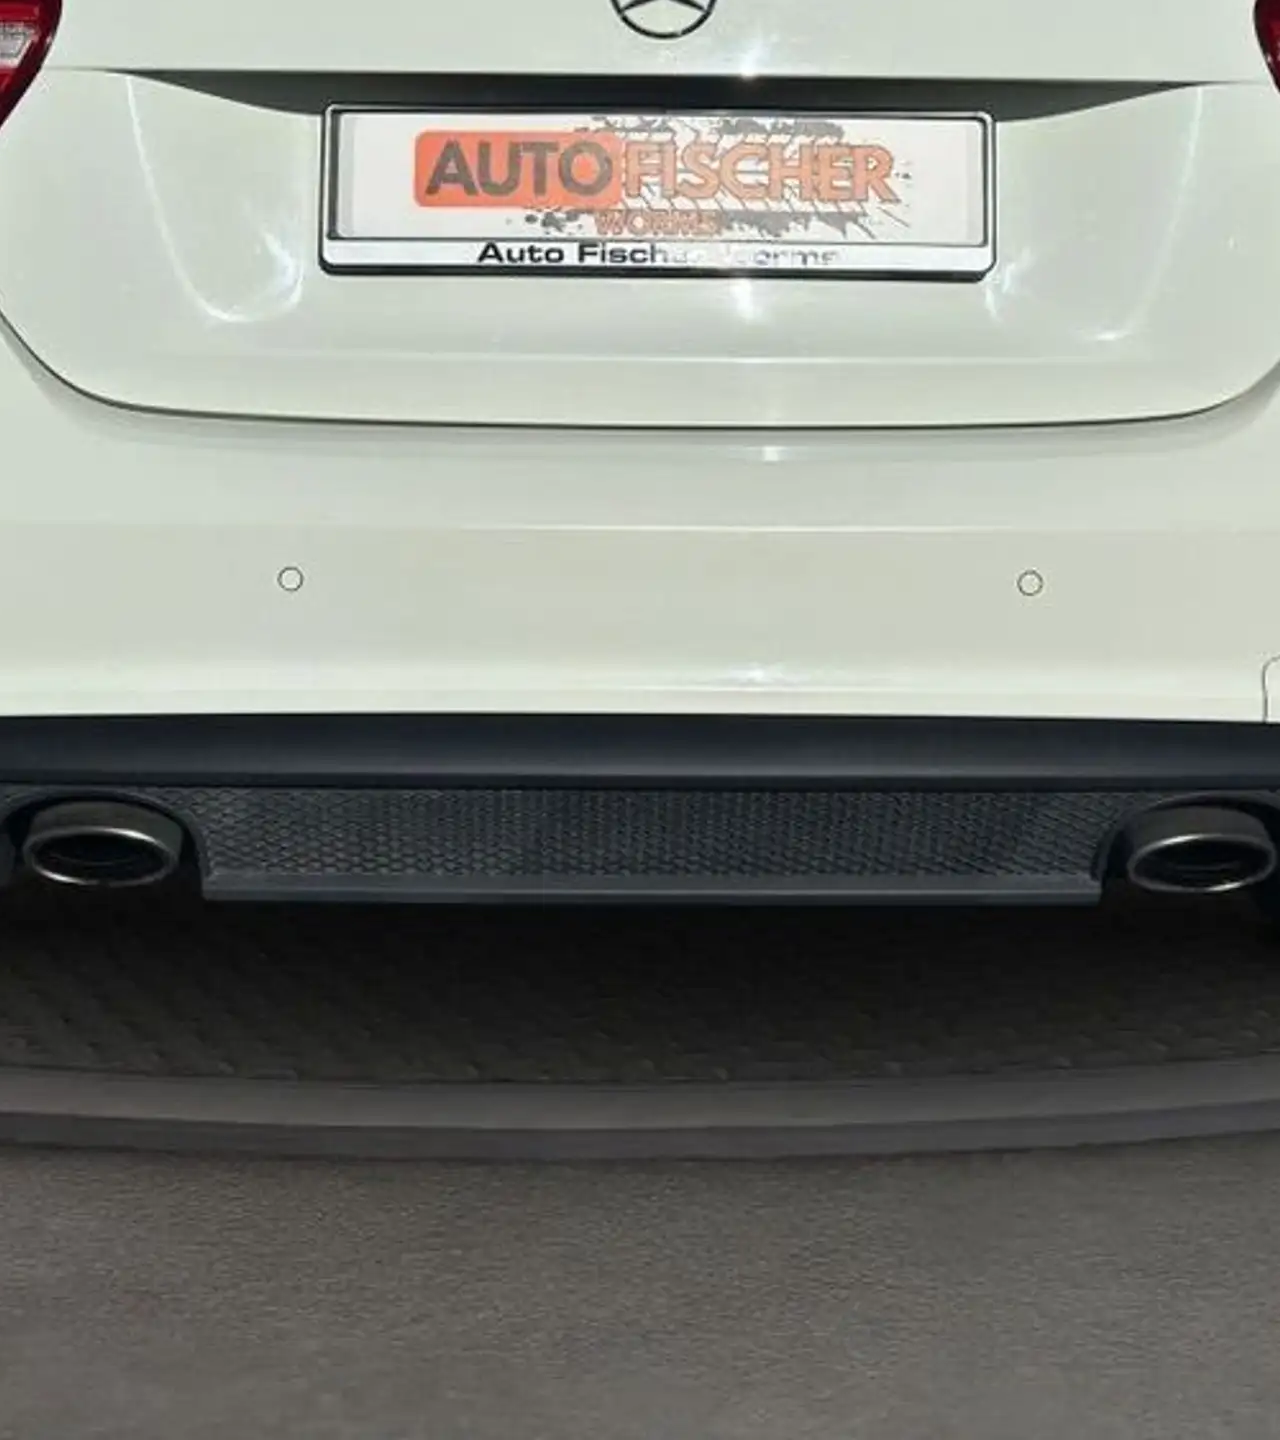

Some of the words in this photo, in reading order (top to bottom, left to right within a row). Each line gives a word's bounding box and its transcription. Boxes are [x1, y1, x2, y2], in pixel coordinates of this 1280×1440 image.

[425, 139, 613, 197] AUTO
[625, 142, 900, 203] FISCHER
[479, 242, 565, 265] Auto
[579, 242, 695, 265] Fisch
